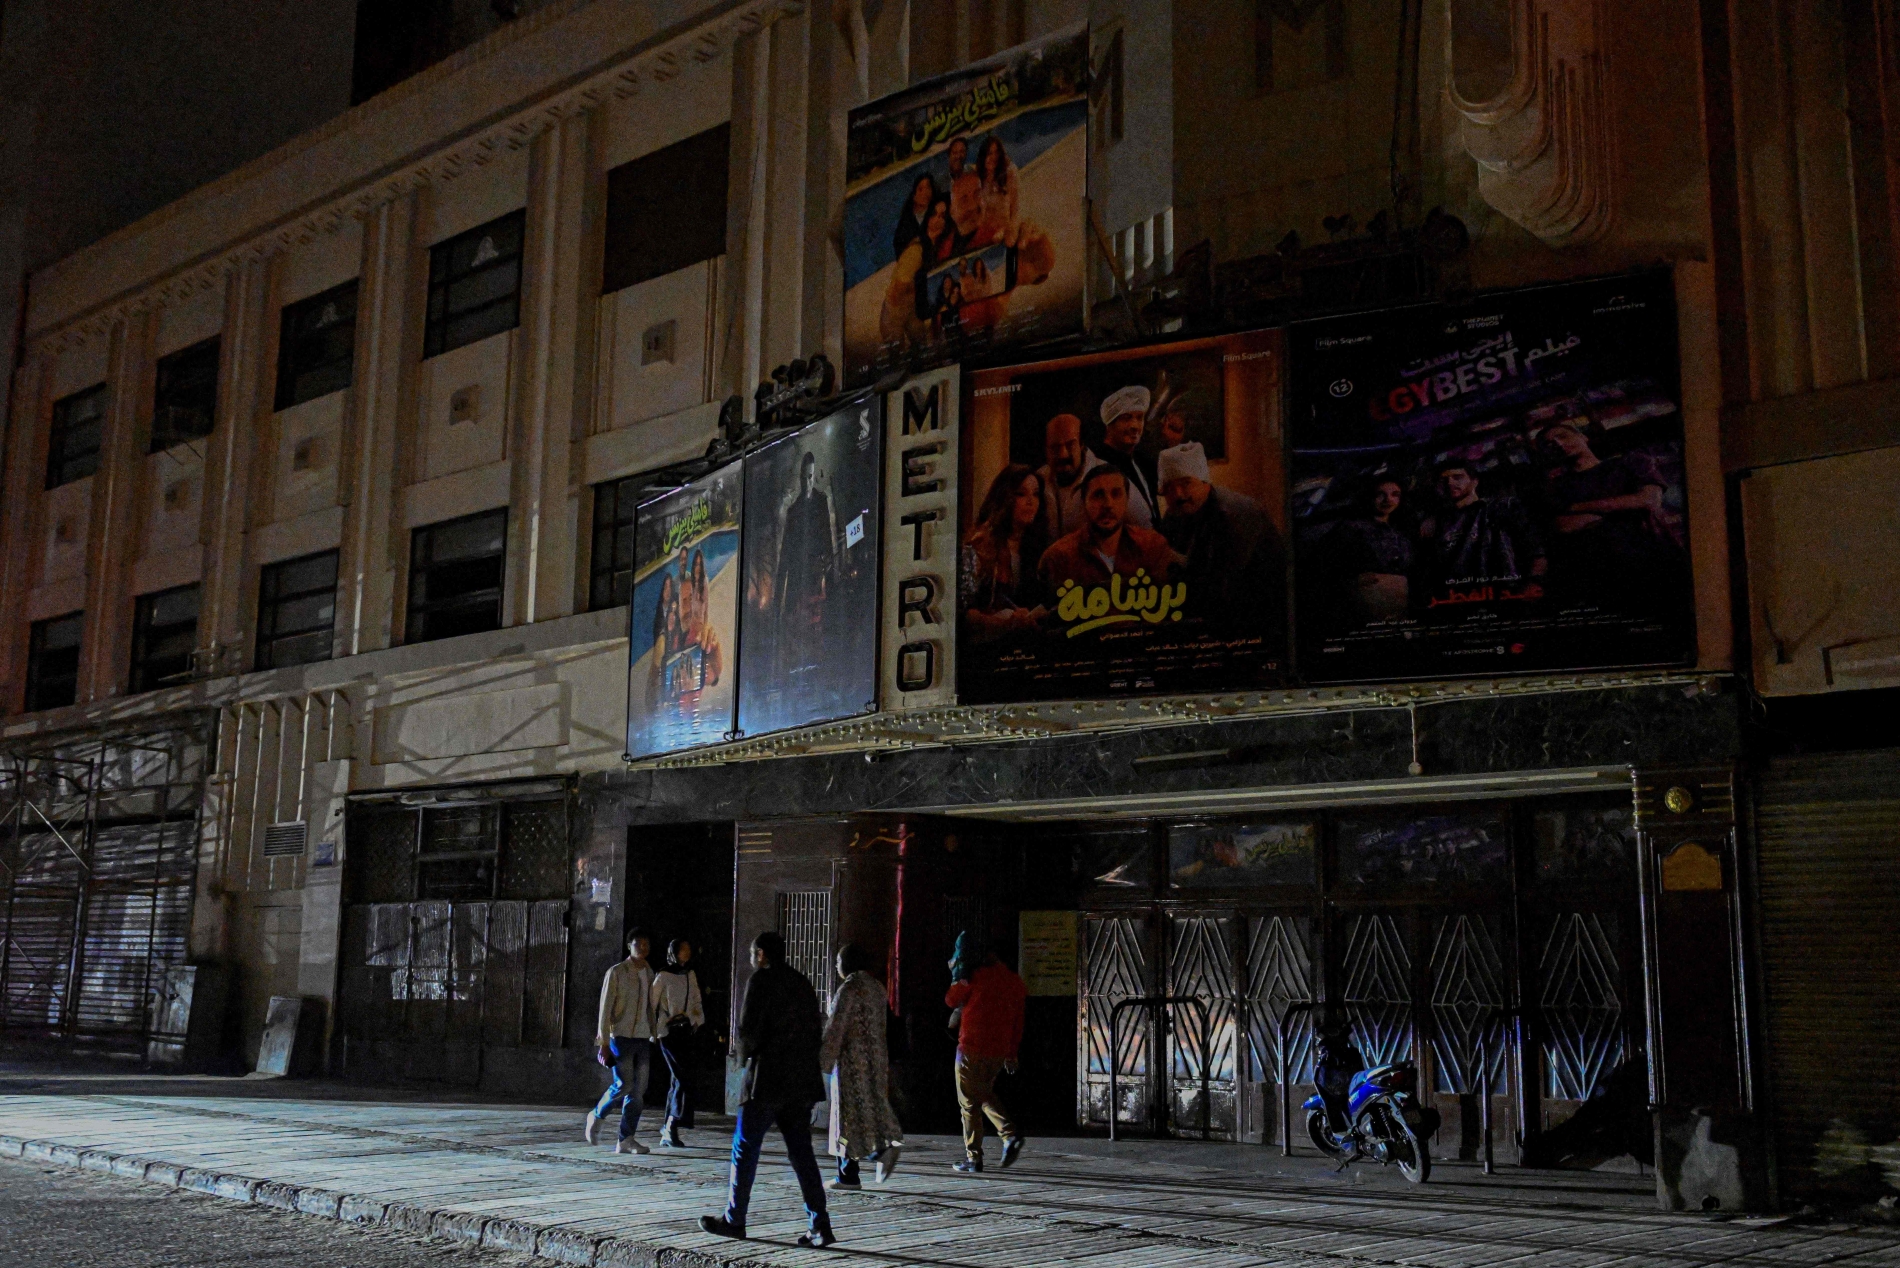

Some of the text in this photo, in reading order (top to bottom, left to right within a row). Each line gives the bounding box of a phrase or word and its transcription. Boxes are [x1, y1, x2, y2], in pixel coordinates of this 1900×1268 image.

[912, 75, 1009, 152] فاميلي بيزنس
[1222, 354, 1241, 362] Film
[1523, 331, 1582, 371] فيلم
[1367, 347, 1519, 422] EGYBEST
[663, 497, 709, 554] فاميلي بيزنس
[850, 523, 861, 536] +18
[896, 384, 944, 692] METRO
[1056, 567, 1187, 623] برشامة
[1426, 585, 1495, 609] الفطر
